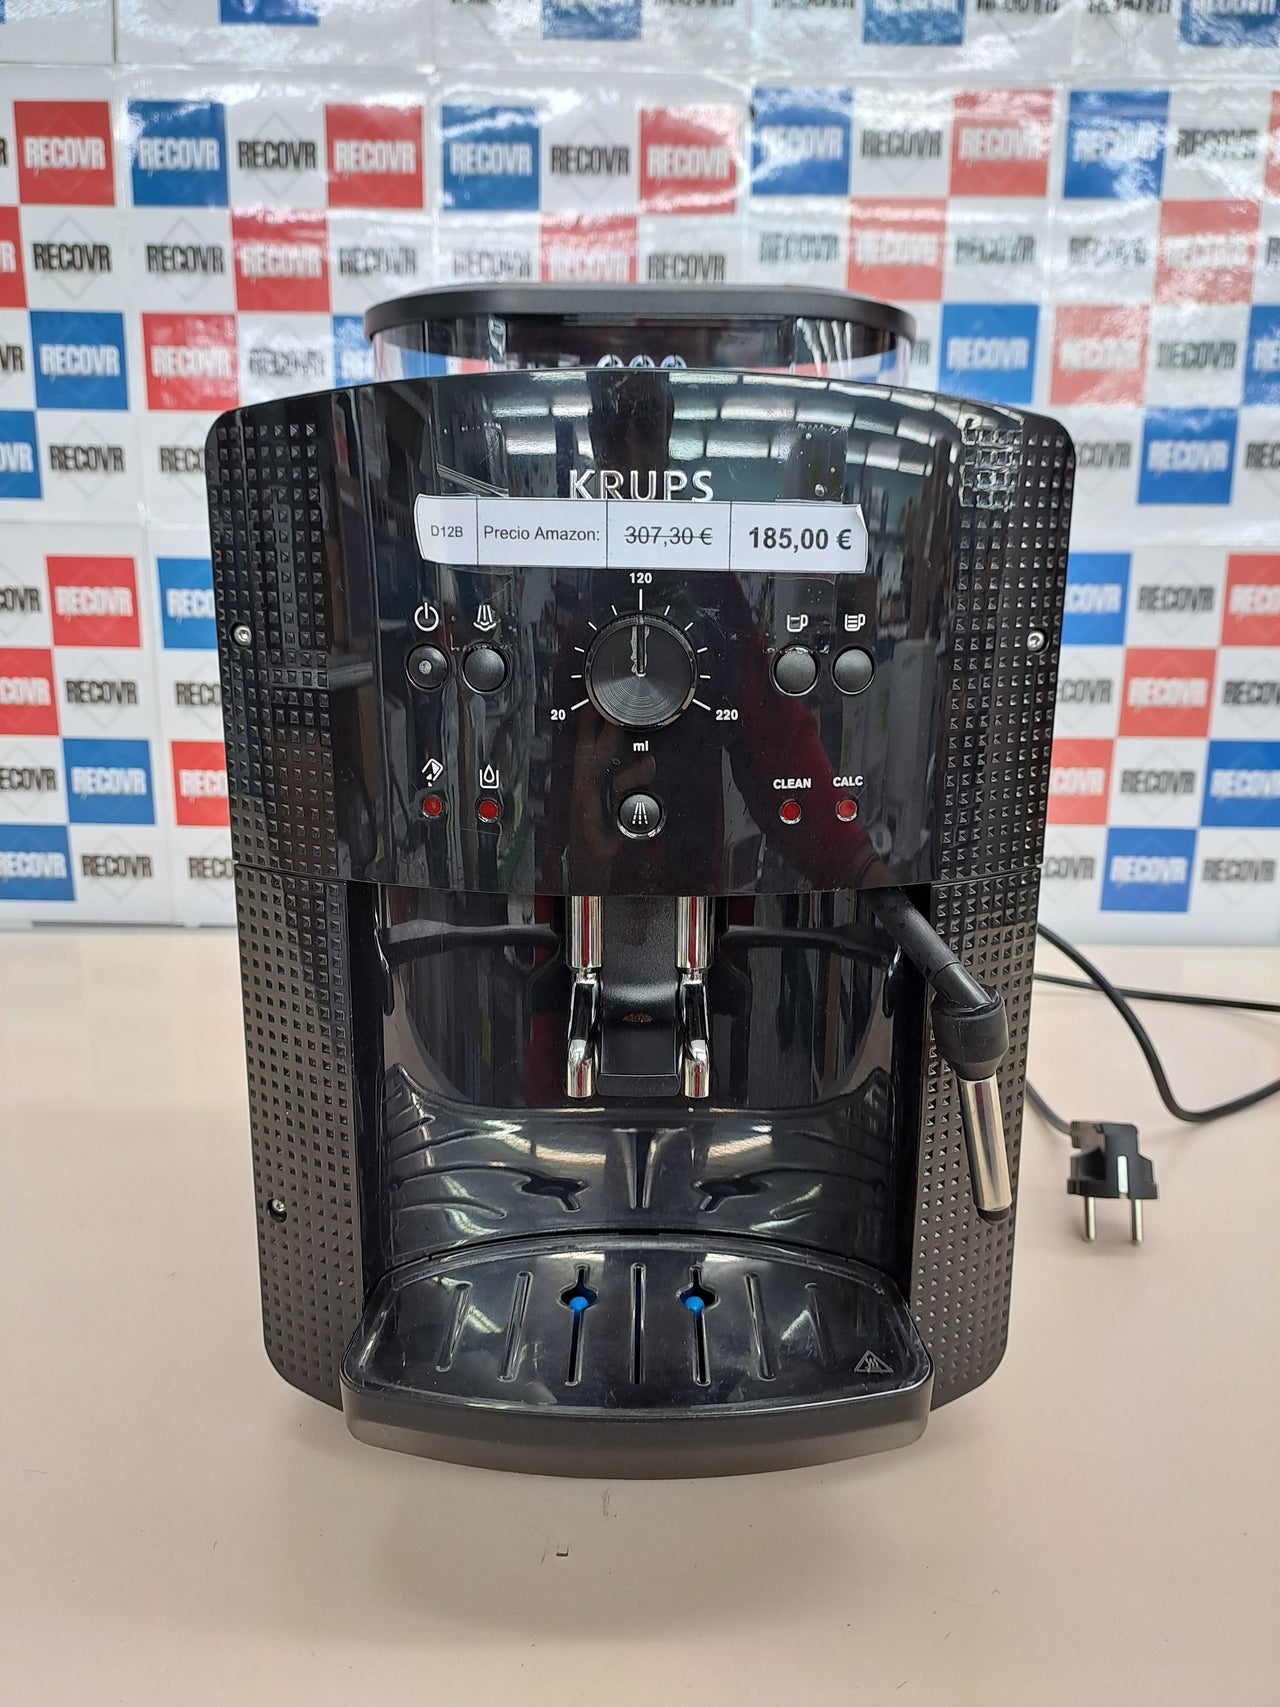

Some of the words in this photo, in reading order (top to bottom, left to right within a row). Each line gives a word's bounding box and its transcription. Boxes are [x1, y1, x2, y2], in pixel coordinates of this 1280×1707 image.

[24, 136, 106, 169] RECOVR
[138, 136, 220, 171] RECOVR
[238, 140, 318, 169] RECOVR
[333, 140, 416, 174] RECOVR
[861, 128, 942, 159] RECOVR
[451, 142, 532, 176] RECOVR
[551, 145, 629, 175] RECOVR
[647, 145, 730, 178] RECOVR
[33, 242, 111, 272] RECOVR
[146, 245, 224, 274] RECOVR
[240, 243, 323, 278] RECOVR
[760, 231, 839, 263] RECOVR
[647, 252, 726, 282] RECOVR
[40, 344, 120, 377] RECOVR
[151, 345, 232, 378] RECOVR
[947, 337, 1030, 370] RECOVR
[1156, 341, 1237, 369] RECOVR
[50, 445, 125, 473] RECOVR
[1076, 442, 1132, 469] COVR
[1147, 440, 1229, 471] RECOVR
[569, 469, 714, 501] KRUPS
[430, 525, 463, 538] D12B
[484, 525, 530, 540] Precio
[534, 526, 600, 541] Amazon:
[624, 526, 694, 547] 307,30
[700, 527, 713, 545] €
[749, 527, 829, 553] 185,00
[836, 528, 852, 550] €
[629, 573, 653, 584] 120
[54, 586, 134, 616] RECOVR
[166, 588, 215, 618] RECO
[1065, 583, 1122, 613] COVR
[1138, 585, 1215, 611] RECOVR
[66, 679, 137, 705] RECOVR
[176, 681, 221, 706] RECO
[1058, 679, 1112, 704] COVR
[1128, 677, 1208, 707] RECOVR
[550, 709, 566, 721] 20
[715, 709, 738, 721] 220
[633, 741, 649, 752] ml
[71, 766, 147, 795] RECOVR
[179, 769, 228, 797] RECO
[773, 778, 812, 789] CLEAN
[833, 776, 864, 788] CALC
[1051, 766, 1105, 796] COVR
[1120, 770, 1196, 794] RECOVR
[82, 855, 153, 879] RECOVR
[189, 856, 234, 879] RECO
[1044, 856, 1095, 880] COVR
[1110, 855, 1188, 884] RECOVR
[1203, 858, 1276, 882] RECOVR
